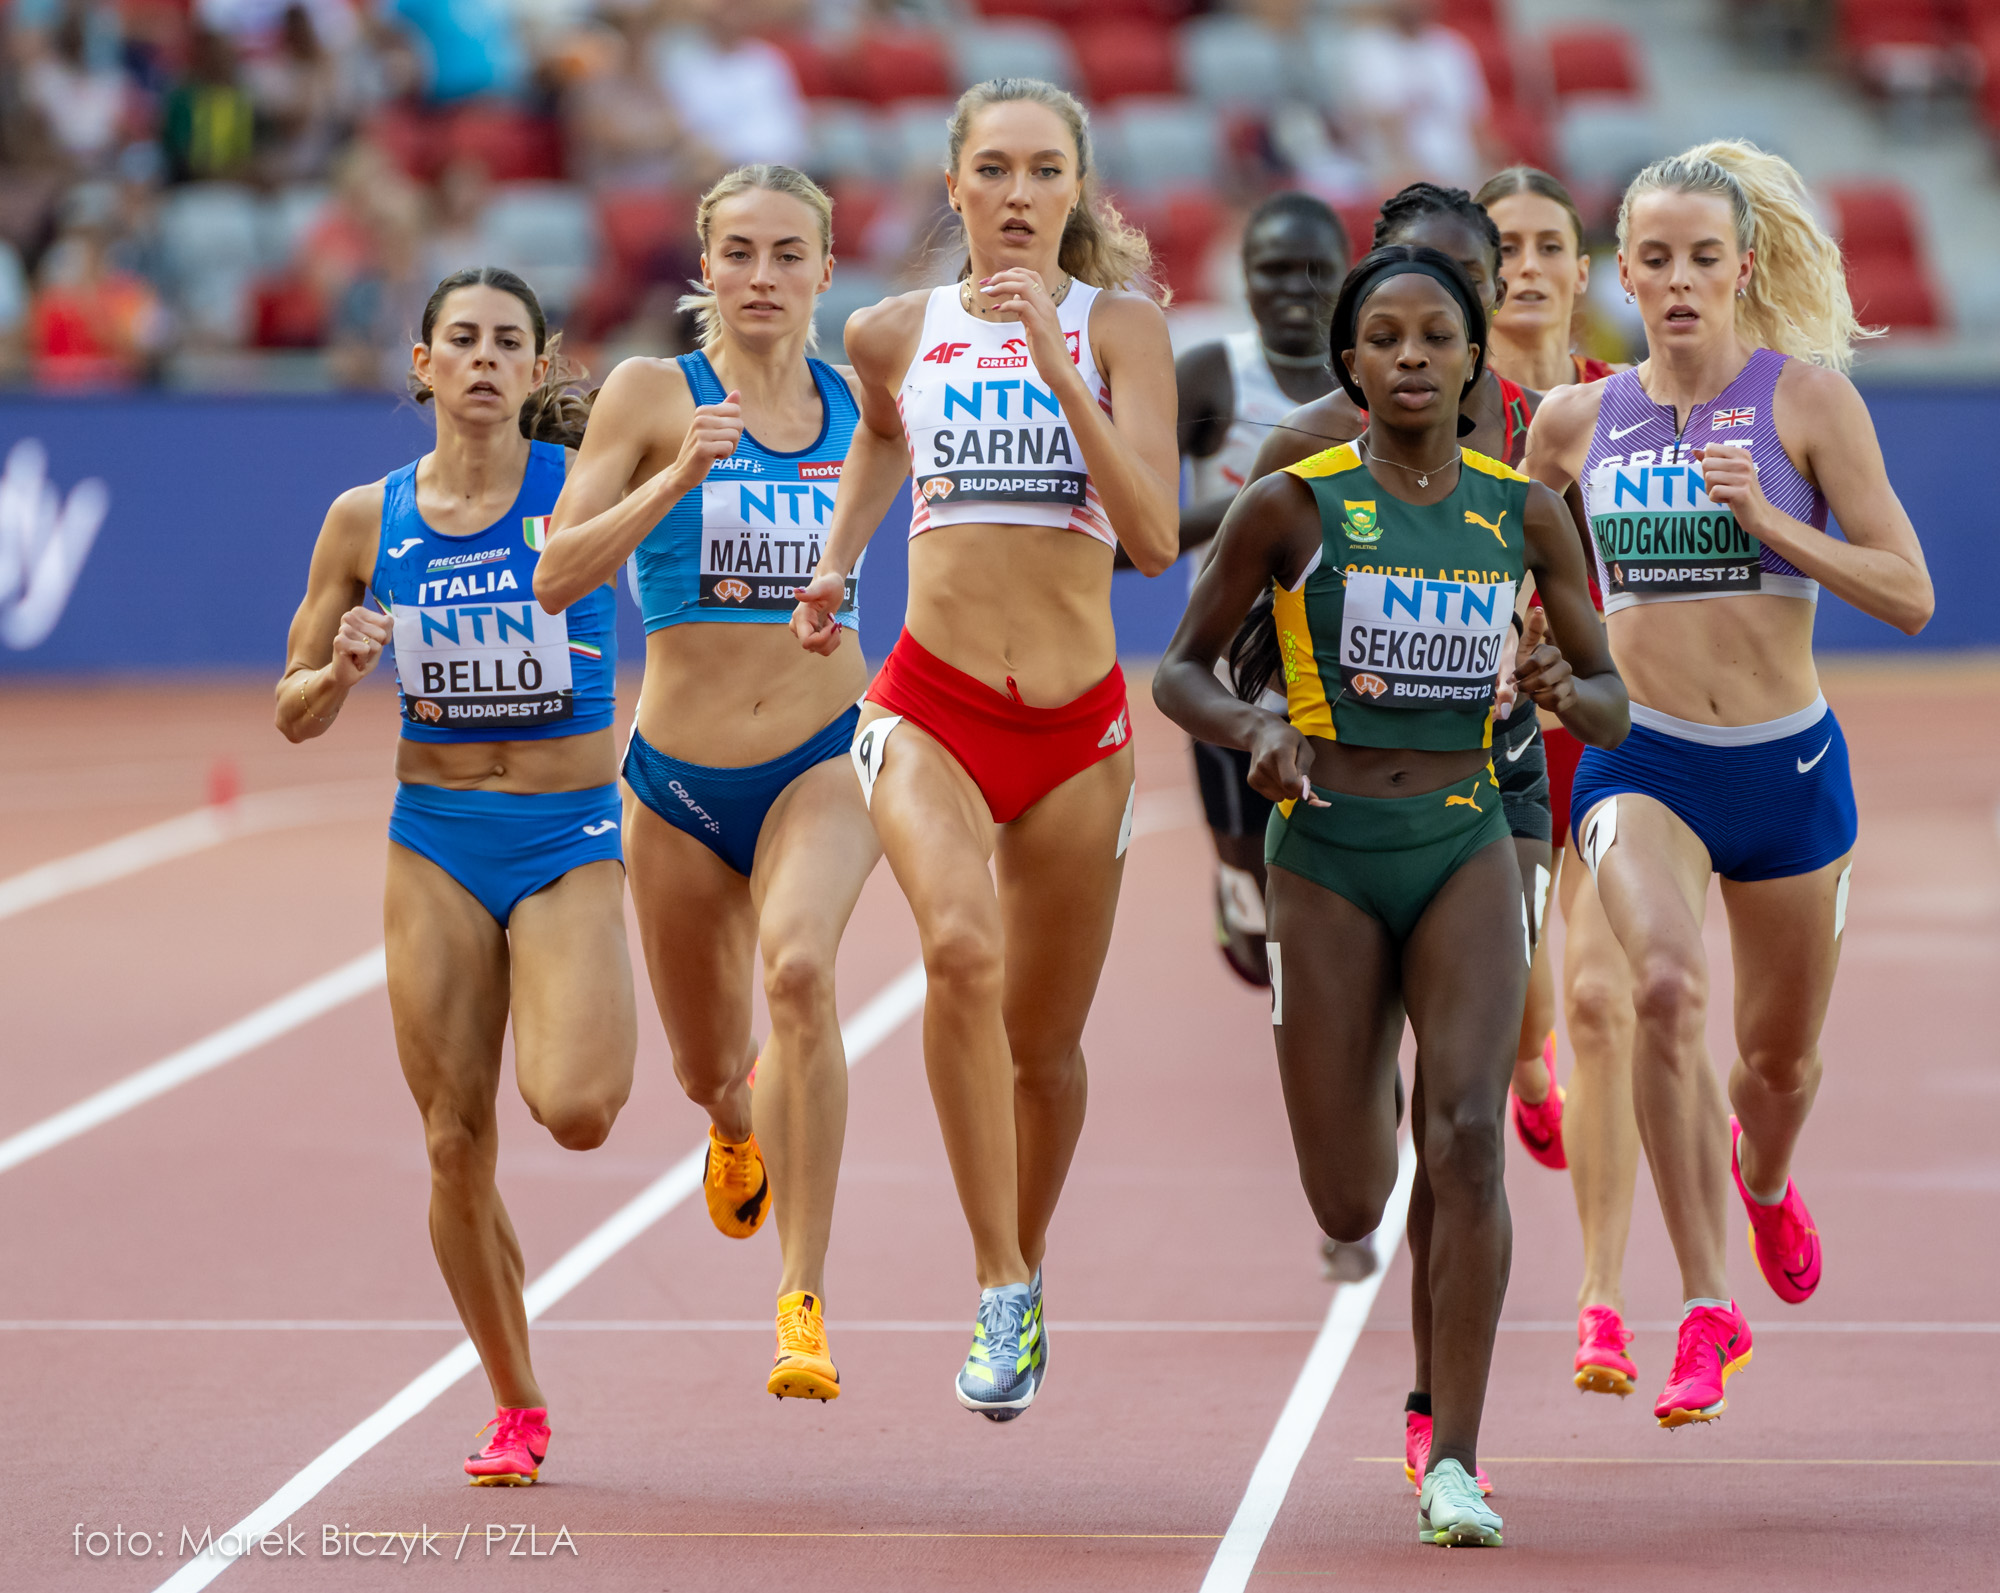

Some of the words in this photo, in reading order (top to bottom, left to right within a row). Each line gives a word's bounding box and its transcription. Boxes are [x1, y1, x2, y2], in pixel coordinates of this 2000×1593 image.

[923, 342, 972, 364] 4F
[980, 358, 1025, 367] ORLEN
[944, 379, 1060, 421] NTN
[711, 458, 752, 471] RAFT
[933, 426, 1073, 468] SARNA
[959, 478, 1060, 492] BUDAPEST
[1062, 480, 1079, 495] 23
[1596, 516, 1750, 558] HODGKINSON
[427, 547, 511, 568] FRECCIAROSSA
[1628, 568, 1725, 582] BUDAPEST
[1728, 567, 1750, 580] 23
[418, 569, 518, 604] ITALIA
[1383, 577, 1497, 626] NTN
[420, 605, 535, 648] NTN
[1348, 625, 1501, 674] SEKGODISO
[421, 651, 543, 694] BELLÒ
[1393, 682, 1481, 700] BUDAPEST
[1481, 684, 1492, 699] 23
[447, 702, 541, 718] BUDAPEST
[543, 699, 563, 713] 23
[860, 731, 874, 784] 9
[668, 780, 712, 821] CRAFT
